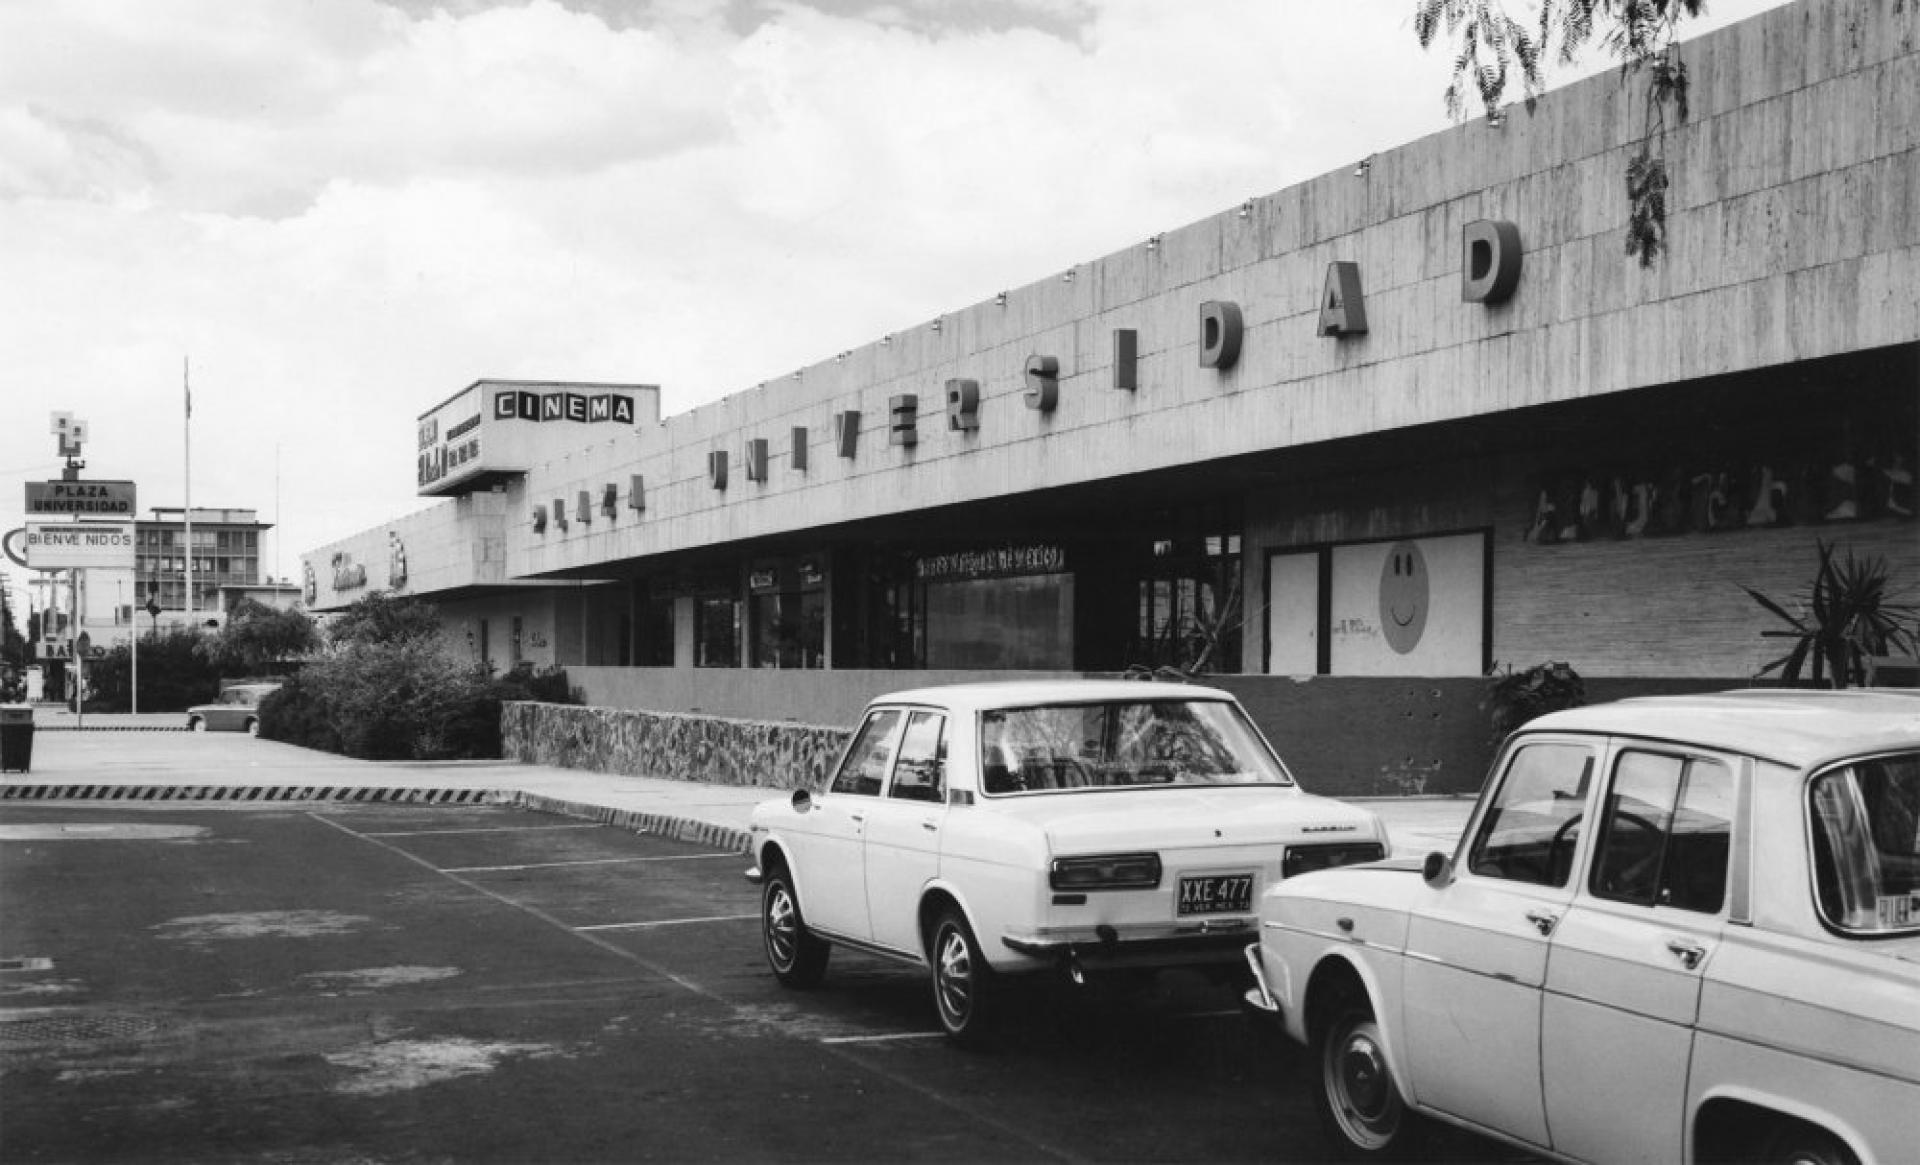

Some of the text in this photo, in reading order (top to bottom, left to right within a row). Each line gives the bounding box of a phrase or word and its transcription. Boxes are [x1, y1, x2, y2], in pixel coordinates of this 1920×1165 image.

[708, 219, 1522, 490] UNIVERSIDAD
[498, 394, 631, 421] CINEMA
[54, 485, 109, 498] PLAZA
[33, 500, 128, 512] UNIVERSIDAD
[1181, 878, 1251, 903] XXE 477
